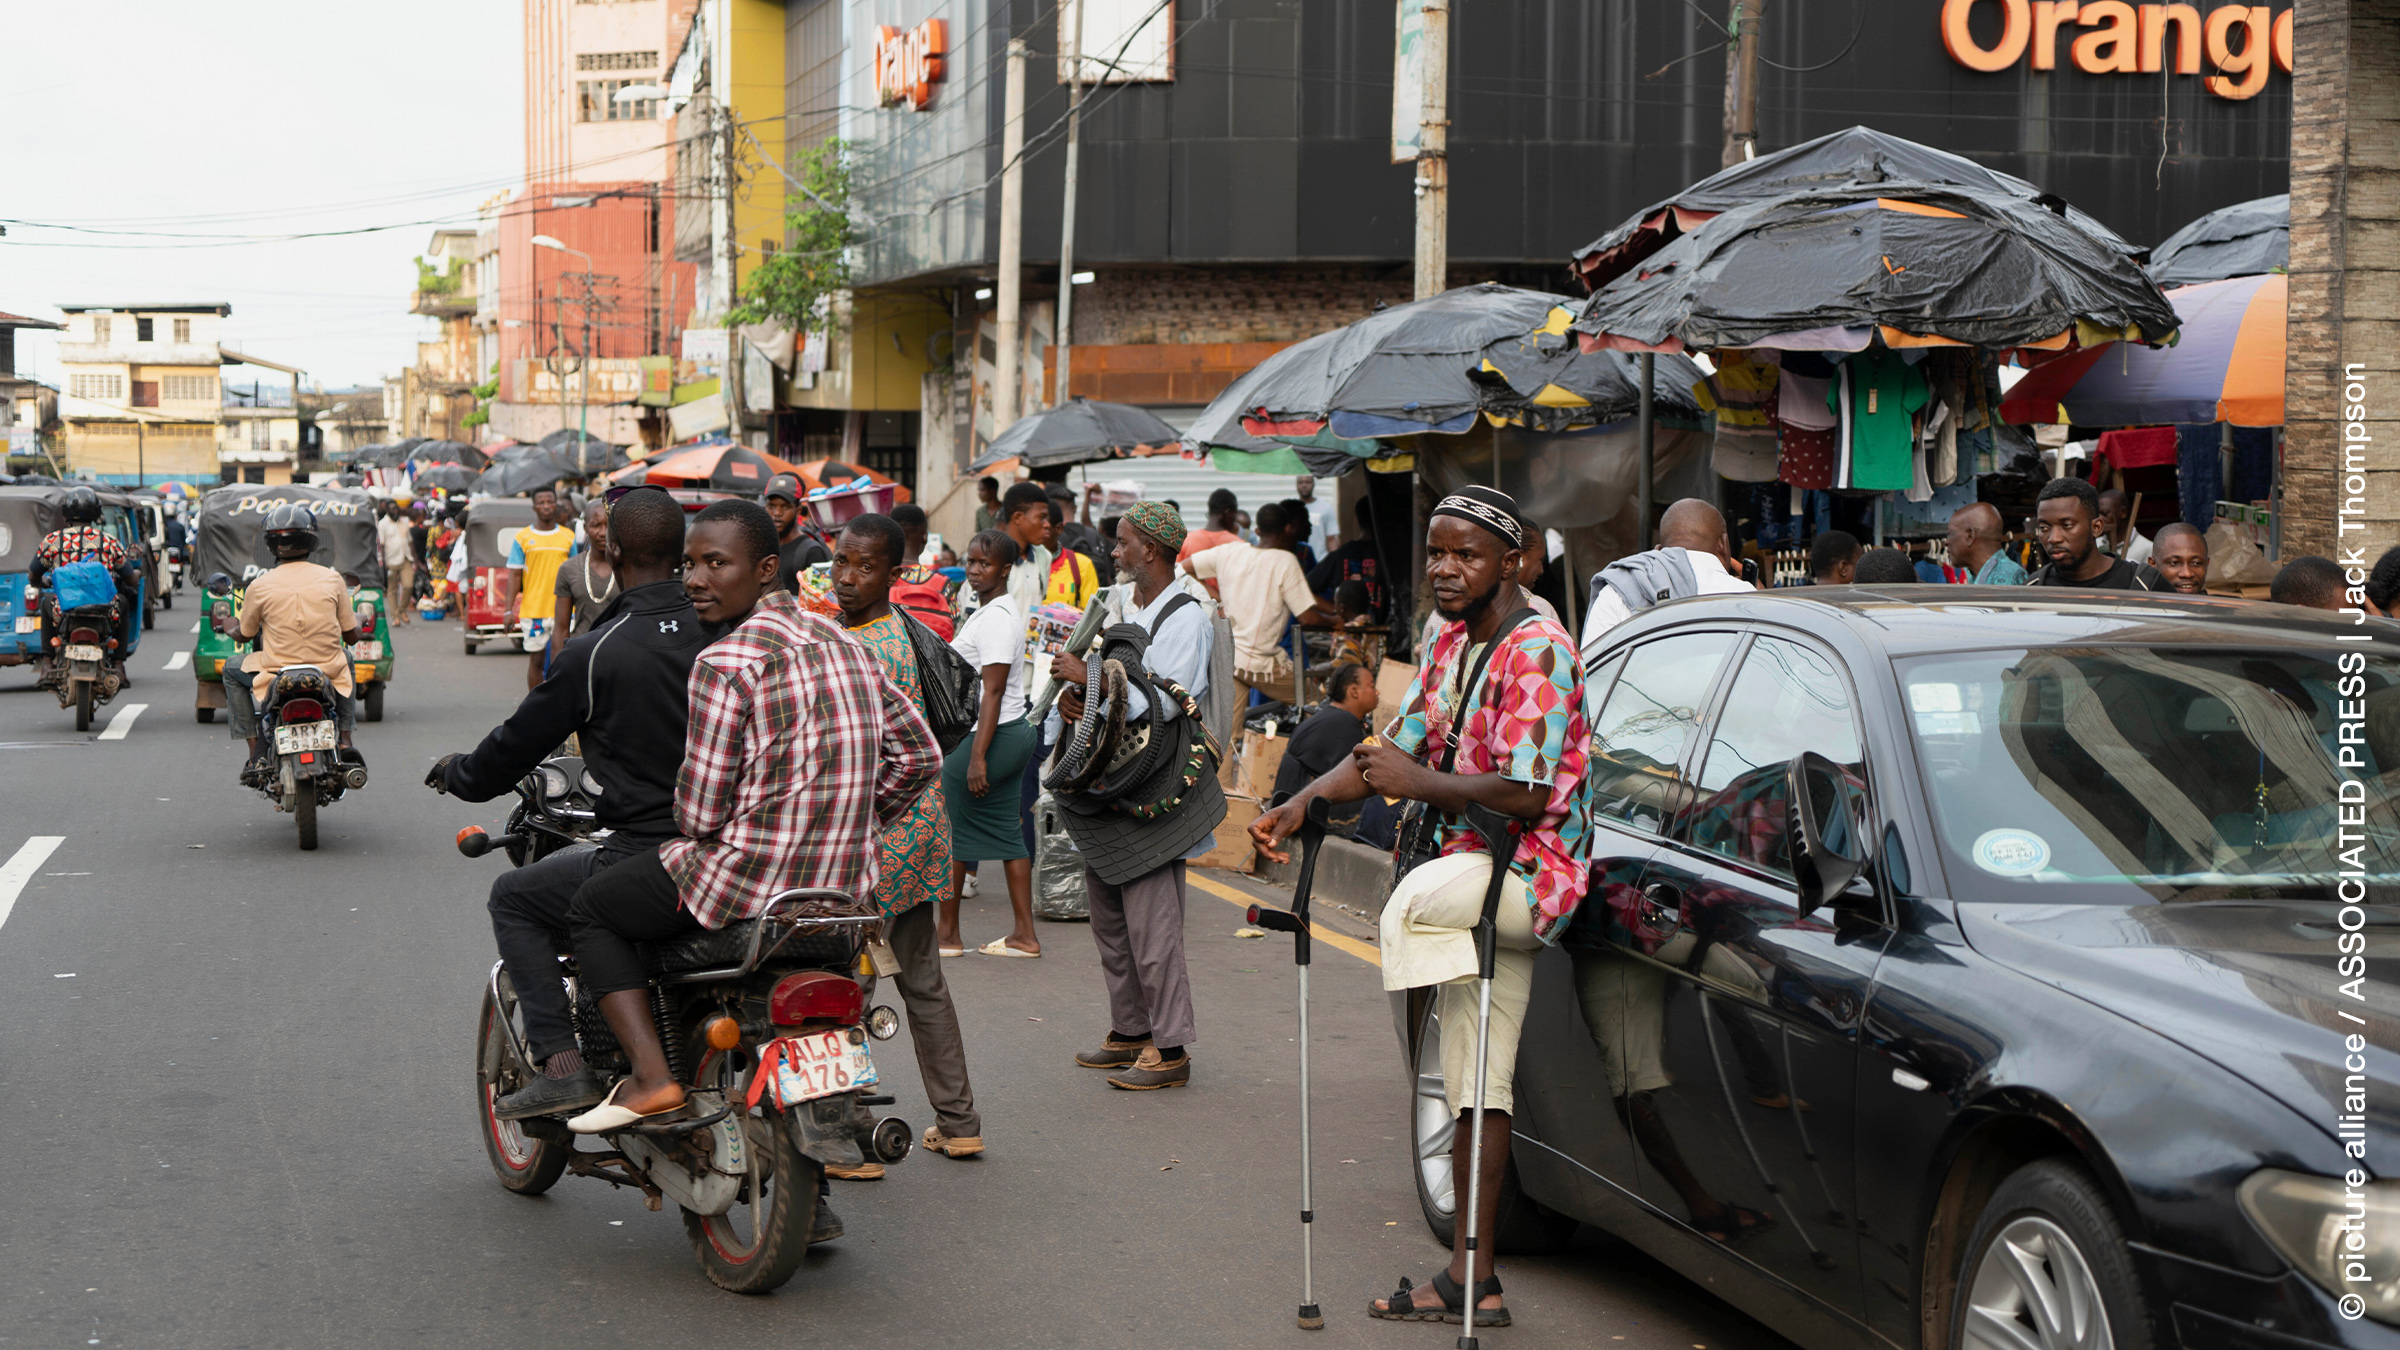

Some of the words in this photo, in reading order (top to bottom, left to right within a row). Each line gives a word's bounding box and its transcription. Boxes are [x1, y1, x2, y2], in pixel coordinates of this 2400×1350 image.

[873, 17, 942, 112] Orange
[242, 564, 274, 581] Po
[289, 721, 319, 738] ARY
[291, 738, 320, 751] 88
[793, 1032, 843, 1063] ALQ
[800, 1062, 850, 1095] 176
